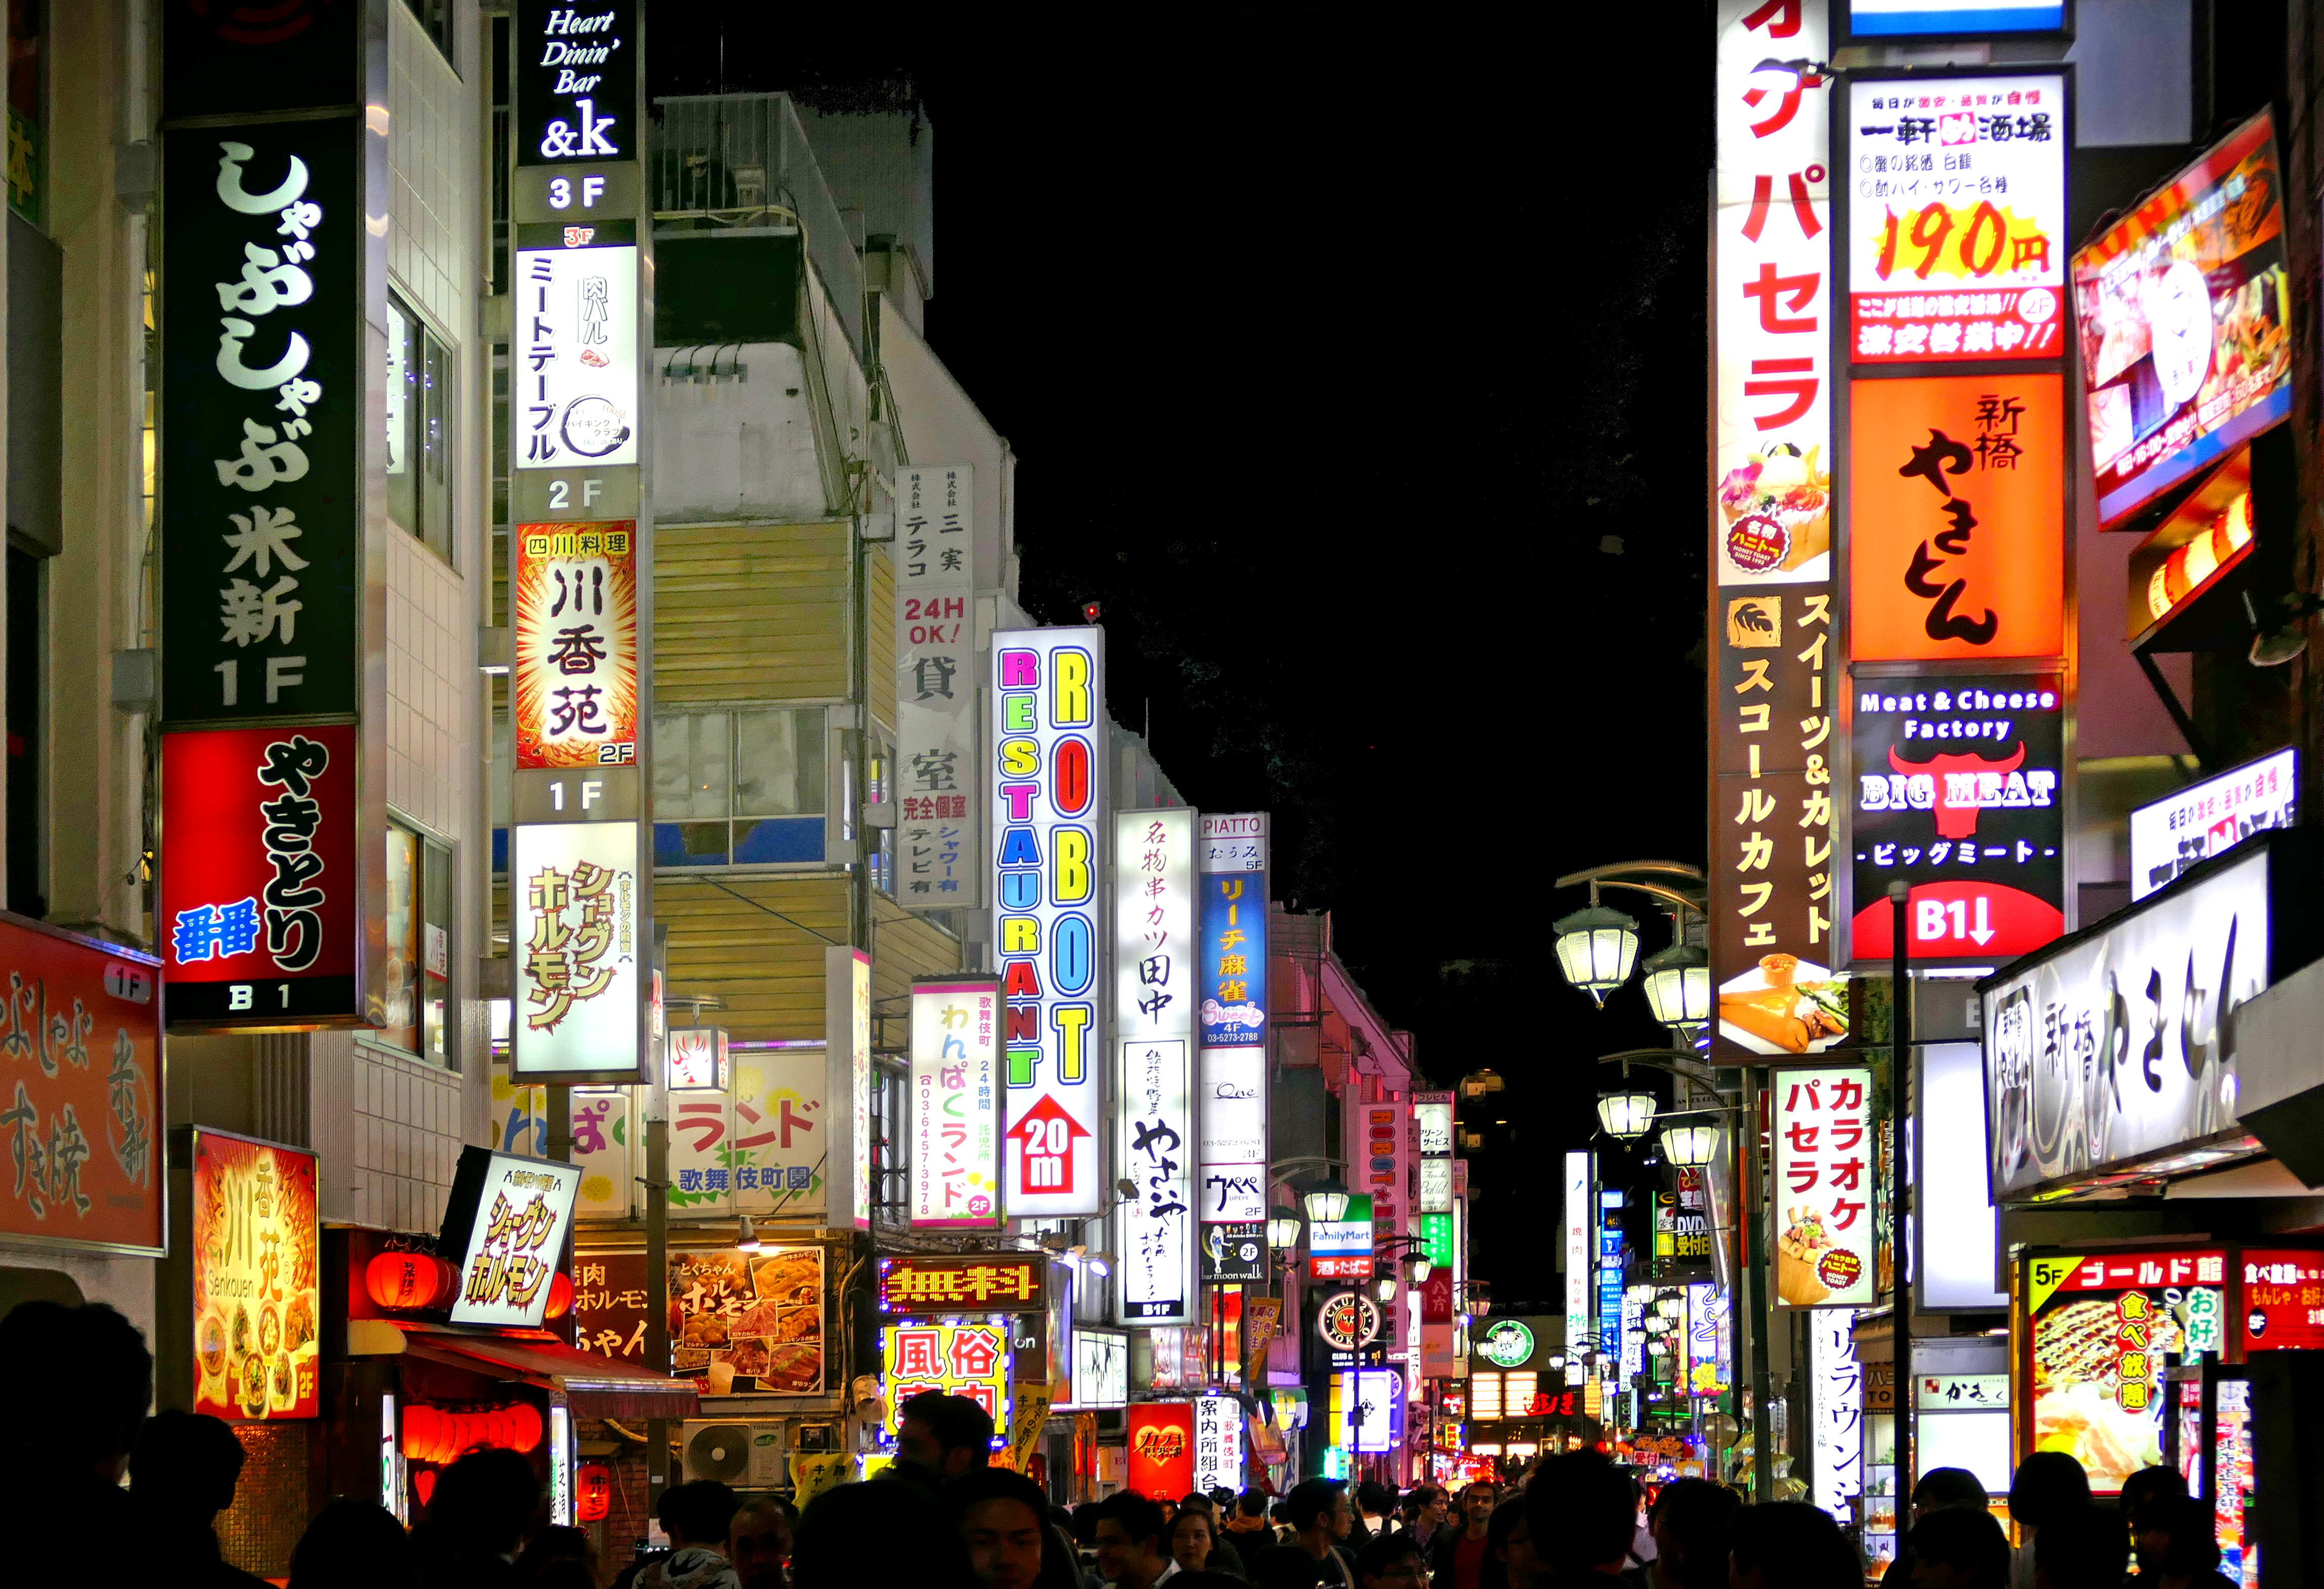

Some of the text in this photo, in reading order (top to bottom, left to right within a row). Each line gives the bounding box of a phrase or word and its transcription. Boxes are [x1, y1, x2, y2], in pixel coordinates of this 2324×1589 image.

[544, 10, 615, 35] Heart
[540, 38, 621, 66] Dinin'
[554, 69, 602, 94] Bar
[540, 99, 618, 158] &k
[1861, 111, 2052, 146] 一軒め酒場
[549, 177, 605, 208] 3F
[564, 227, 595, 247] 3F
[1875, 200, 2051, 281] 190円
[583, 276, 609, 345] 肉バル
[2025, 295, 2051, 314] 2F
[527, 257, 558, 462] ミートテーブル
[215, 141, 323, 648] しゃぶしゃぶ 米新
[1974, 394, 2026, 471] 新橋
[550, 480, 603, 508] 2F
[906, 473, 928, 577] 株式会社 テラコ
[940, 471, 963, 572] 株式会社 三実
[1747, 520, 1777, 539] 名物
[529, 534, 626, 554] 四川料理
[1731, 532, 1780, 553] ハニトー
[1898, 428, 1998, 646] やきとん
[1733, 545, 1771, 561] HONEY TOAST
[1735, 552, 1765, 565] SINCE 1993
[905, 597, 964, 620] 24H
[910, 623, 960, 644] OK!
[547, 566, 607, 736] 川香苑
[214, 656, 307, 706] 1F
[1861, 691, 2055, 712] Meat & Cheese
[1905, 719, 2010, 740] Factory
[599, 743, 635, 764] 2F
[550, 782, 602, 810] 1F
[1735, 659, 1777, 946] スコールカフェ
[1861, 771, 2055, 810] BIG MEAT
[904, 795, 966, 821] 完全個室
[1204, 818, 1260, 834] PIATTO
[257, 735, 329, 971] やきとり
[910, 829, 932, 893] テレビ有
[938, 827, 959, 892] シャワー有
[1049, 646, 1094, 1085] ROBOT
[1209, 845, 1259, 859] おうみ
[1246, 861, 1262, 870] 5F
[997, 648, 1043, 1089] RESTAURANT
[172, 897, 260, 964] 番番
[570, 860, 617, 1001] ショーグン
[1917, 900, 1965, 940] B1
[524, 866, 574, 1033] ホルモン
[1217, 879, 1248, 1002] リーチ麻雀
[116, 967, 141, 998] 1F
[229, 984, 289, 1010] B1
[1202, 1000, 1262, 1025] Sweet
[1207, 1033, 1258, 1042] 03-5273-2788
[1223, 1023, 1241, 1032] 4F
[2045, 1003, 2096, 1089] 新橋
[978, 996, 991, 1161] 歌舞伎町 24時間 託児所
[1217, 1082, 1256, 1097] One
[941, 1004, 968, 1208] わんぱくランド
[1025, 1118, 1068, 1155] 20
[1370, 1110, 1396, 1186] ROBOT
[1423, 1138, 1449, 1146] サービス
[1784, 1079, 1821, 1194] パセラ
[1244, 1149, 1260, 1157] 3F
[1829, 1078, 1866, 1231] カラオケ
[680, 1166, 810, 1191] 歌舞伎町園
[1030, 1155, 1062, 1187] m
[971, 1200, 988, 1211] 2F
[1207, 1175, 1259, 1212] ウペペ
[487, 1190, 557, 1251] ショーグン
[1313, 1231, 1370, 1242] FamilyMart
[1572, 1227, 1582, 1255] 焼肉
[1243, 1248, 1255, 1256] 2F
[464, 1248, 548, 1311] ホルモン
[680, 1263, 736, 1276] とくちゃん
[1202, 1265, 1212, 1279] bar
[1239, 1264, 1263, 1279] walk
[1317, 1261, 1369, 1275] 酒・たばこ
[1822, 1260, 1860, 1273] ハニトー
[1827, 1272, 1849, 1281] HONEY
[2035, 1264, 2063, 1285] 5F
[2081, 1257, 2223, 1286] ゴールド館
[2245, 1263, 2297, 1284] 食べ放題
[208, 1272, 254, 1299] Senkouen
[887, 1265, 1039, 1302] 無料
[1827, 1277, 1846, 1286] TOAST
[679, 1280, 765, 1317] ホルモン
[1143, 1304, 1170, 1315] B1F
[1329, 1326, 1371, 1345] TOKO
[2248, 1314, 2265, 1329] 5F
[892, 1329, 998, 1380] 風俗
[2120, 1291, 2149, 1410] 食べ放題
[300, 1372, 313, 1399] 2F
[1144, 1445, 1182, 1458] 倶楽部
[1223, 1421, 1235, 1469] 歌舞伎町
[1635, 1452, 1658, 1464] 受付
